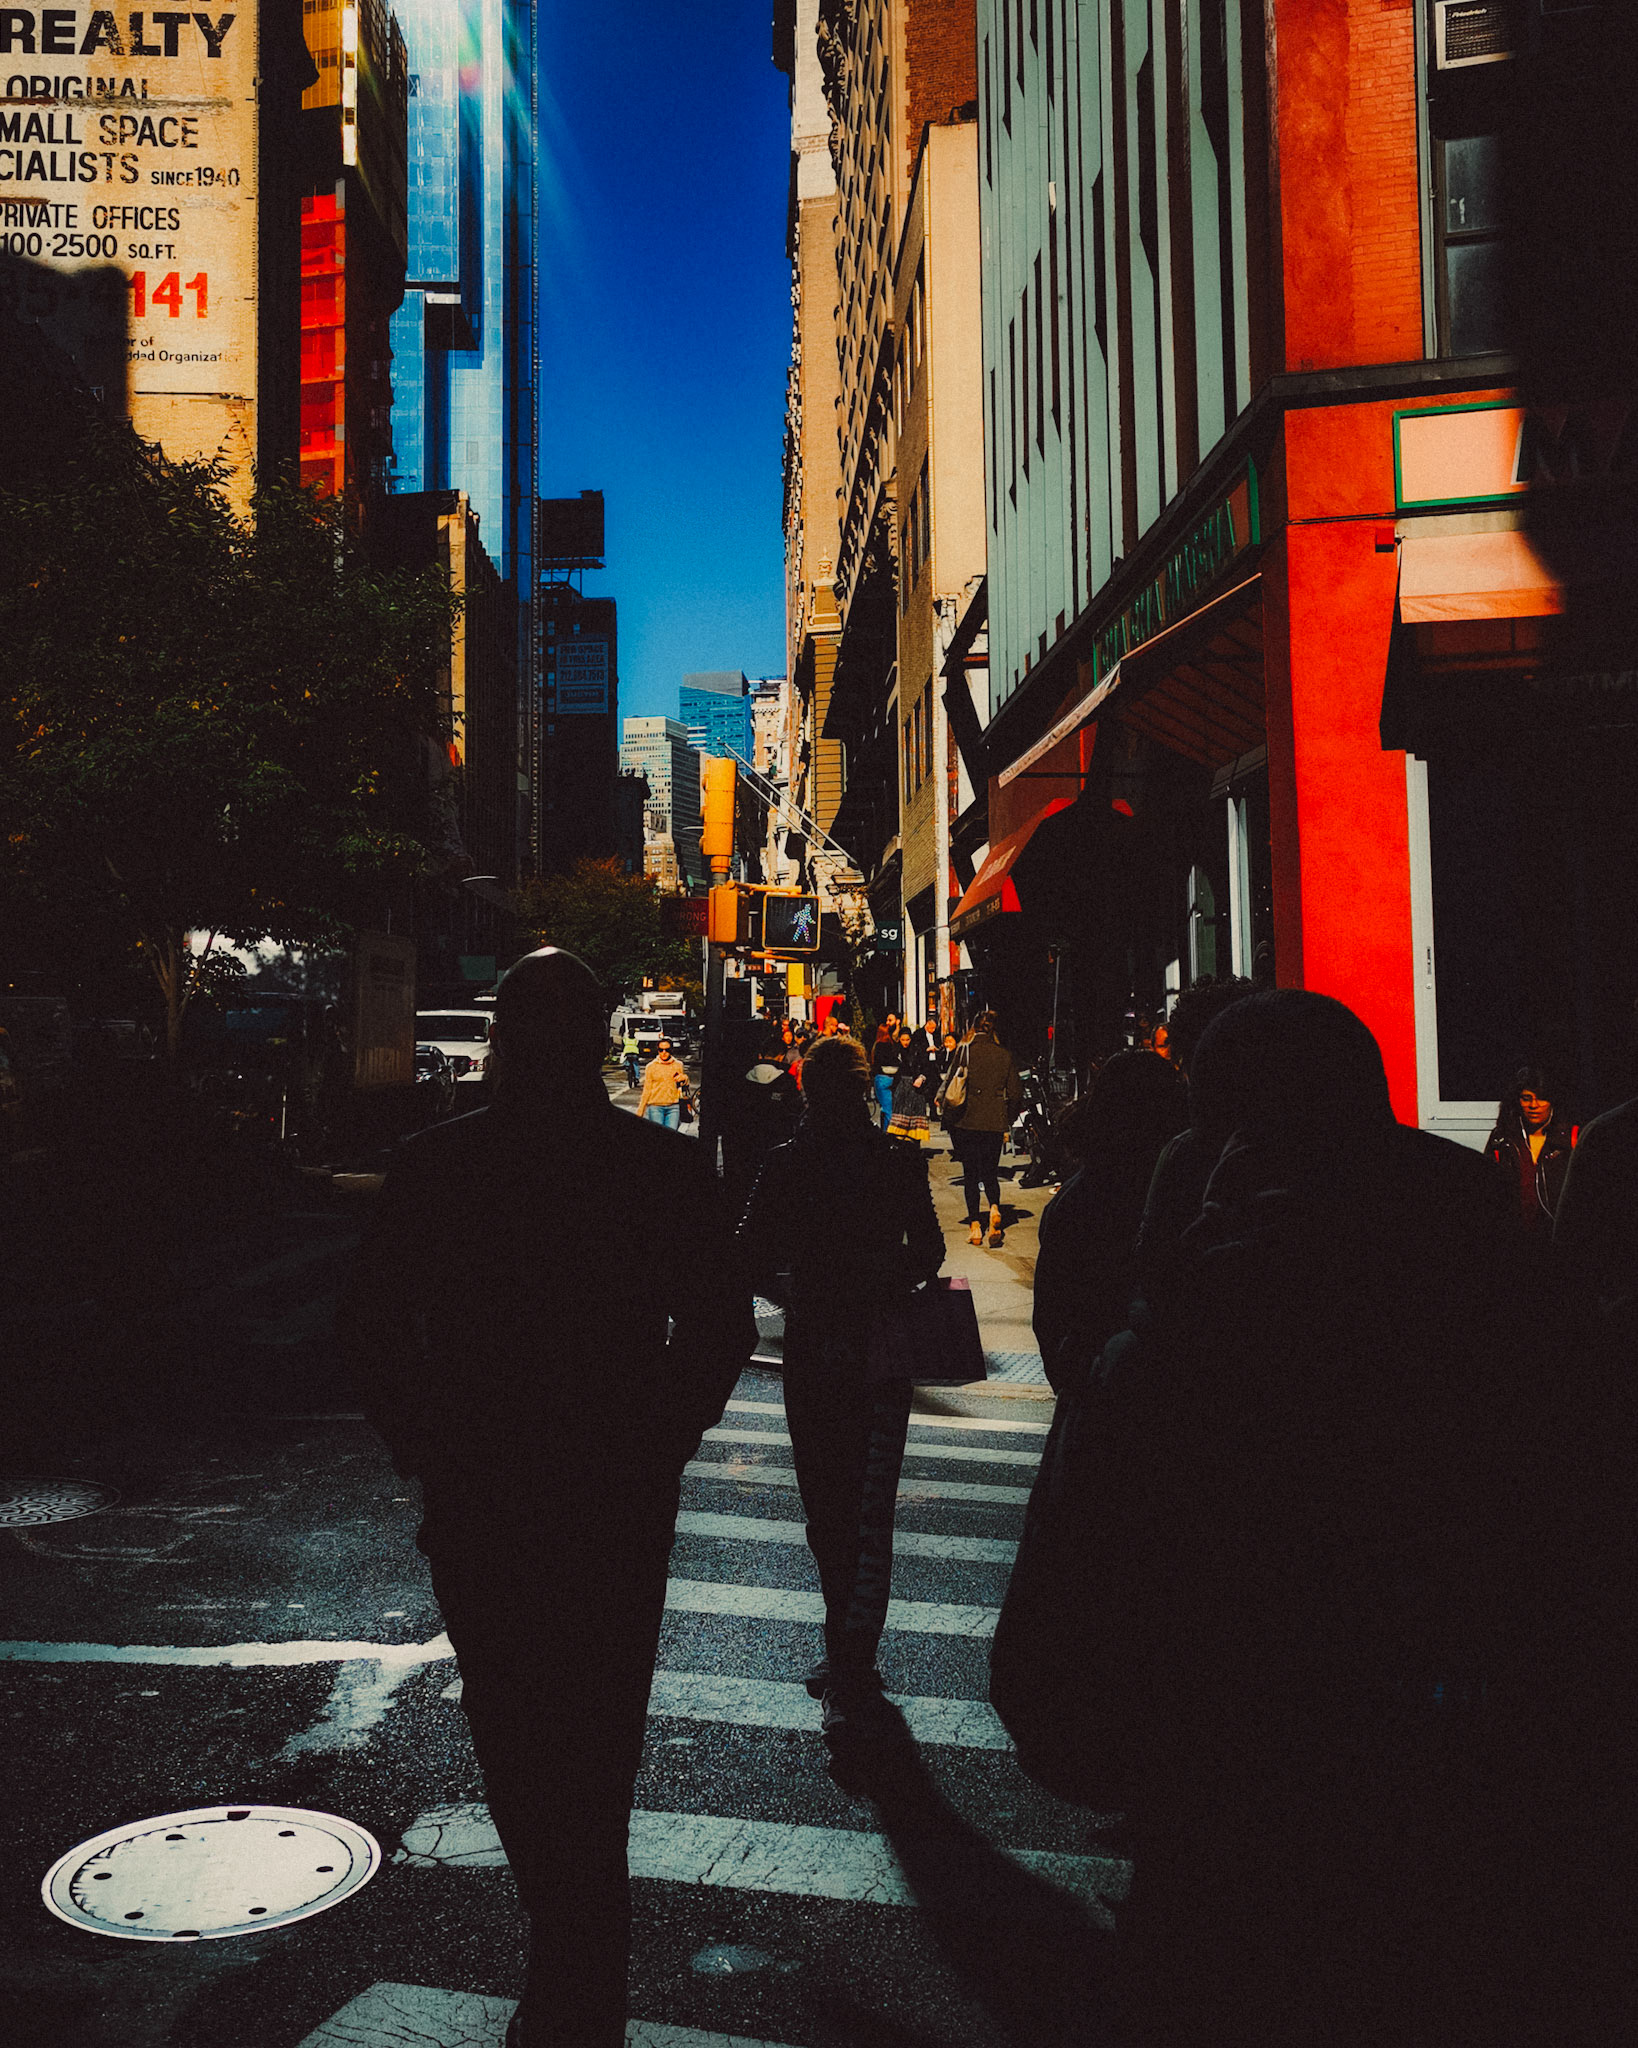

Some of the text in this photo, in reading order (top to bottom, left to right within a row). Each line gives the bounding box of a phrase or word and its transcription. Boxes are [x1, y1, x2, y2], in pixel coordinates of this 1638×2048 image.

[0, 9, 236, 58] REALTY
[6, 75, 149, 99] ORIGINAL
[99, 115, 198, 148] SPACE
[0, 203, 180, 230] RIVATE OFFICES
[880, 929, 899, 941] sg
